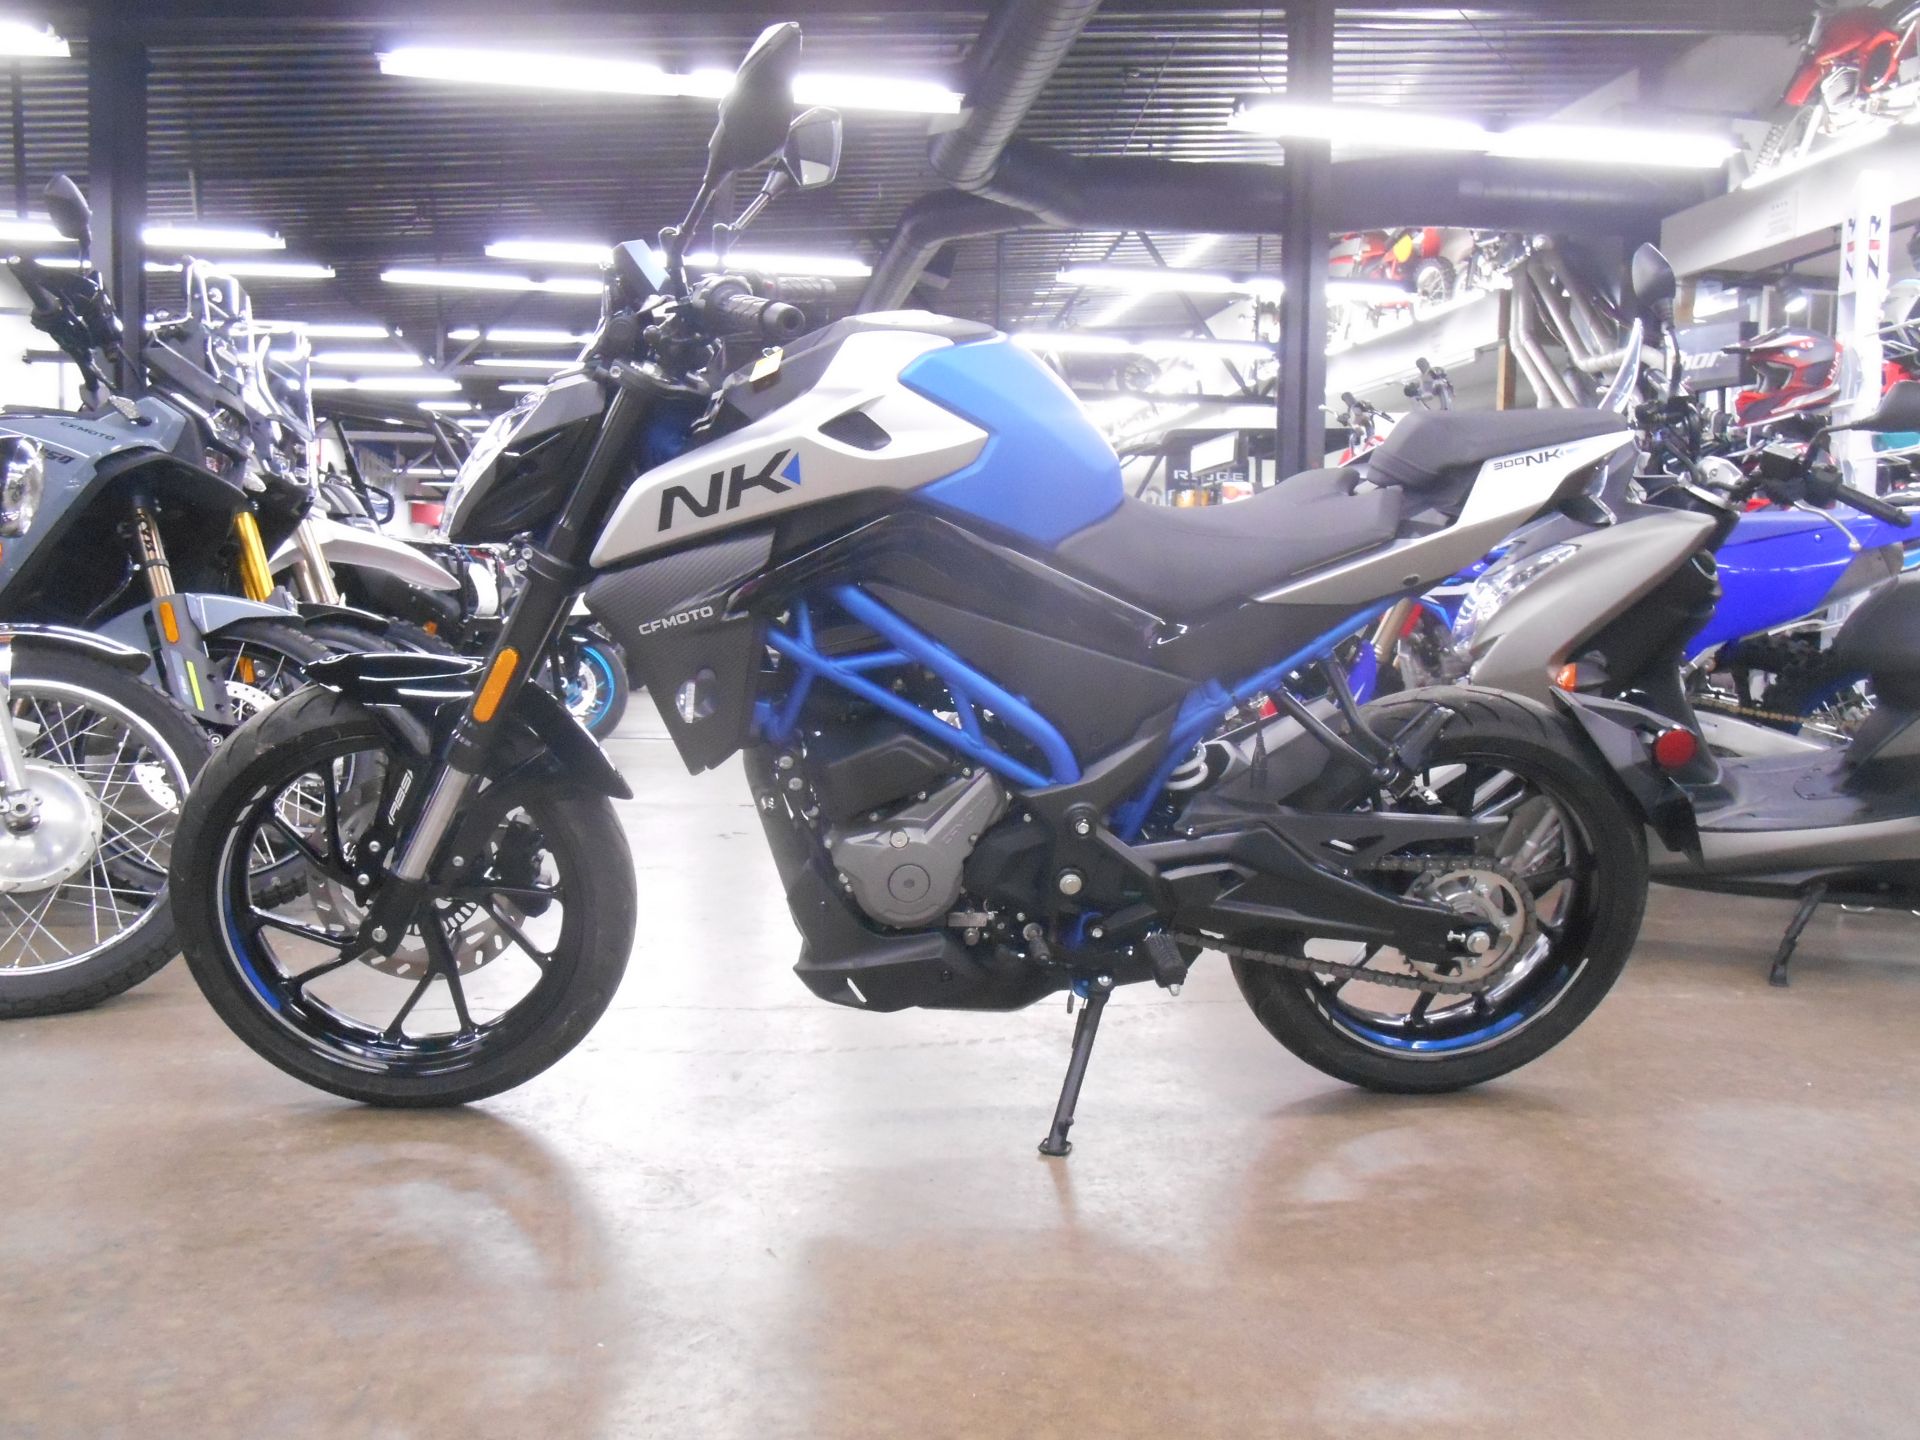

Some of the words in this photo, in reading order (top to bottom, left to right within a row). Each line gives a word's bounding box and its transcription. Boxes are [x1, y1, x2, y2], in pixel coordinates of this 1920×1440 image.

[60, 421, 116, 441] CFMOTO
[1494, 448, 1561, 470] 300NK
[658, 449, 793, 532] NK
[638, 605, 713, 635] CFMOTO
[388, 771, 412, 823] ABS
